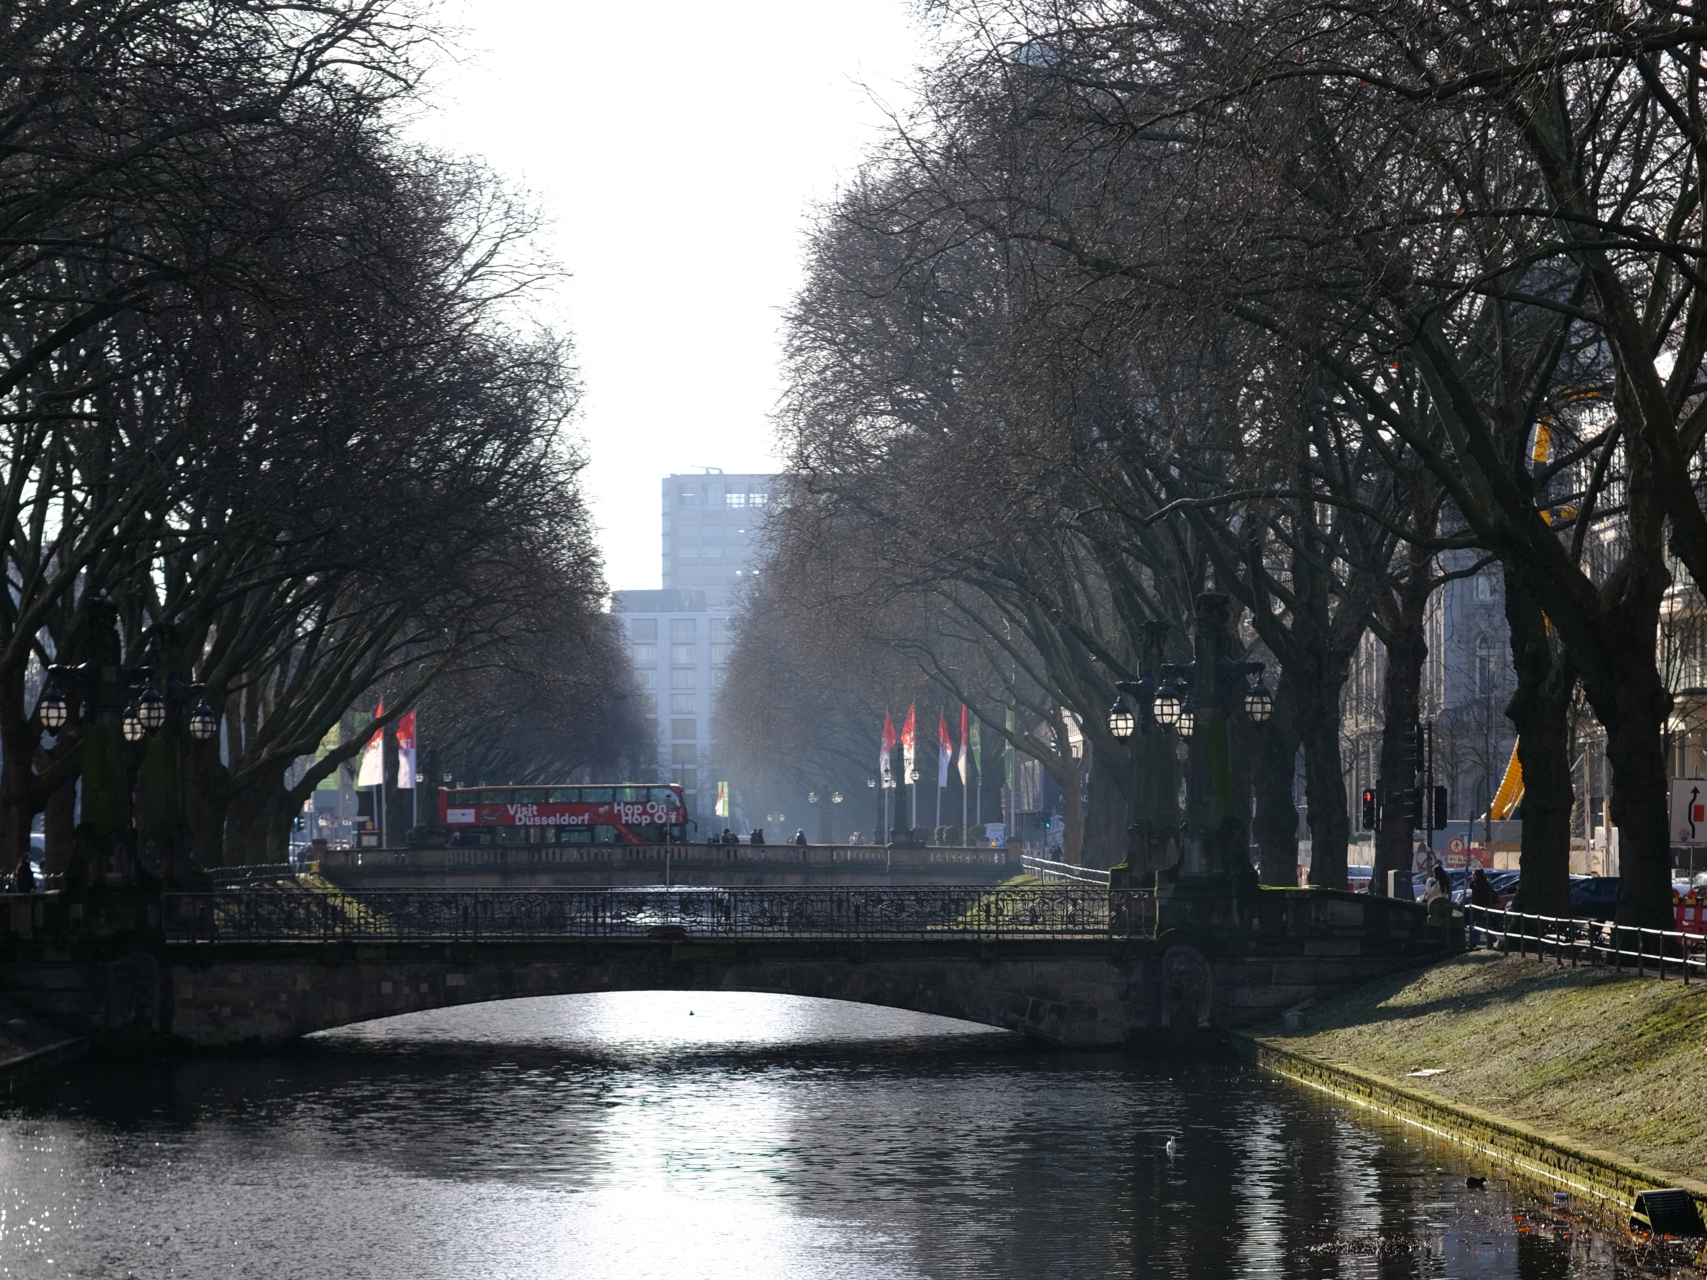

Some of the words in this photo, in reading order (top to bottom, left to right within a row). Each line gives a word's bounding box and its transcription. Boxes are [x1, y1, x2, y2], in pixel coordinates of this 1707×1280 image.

[507, 804, 538, 816] Visit
[614, 802, 643, 816] Hop
[646, 802, 666, 813] On
[515, 813, 589, 825] Düsseldorf
[622, 812, 650, 826] Hop
